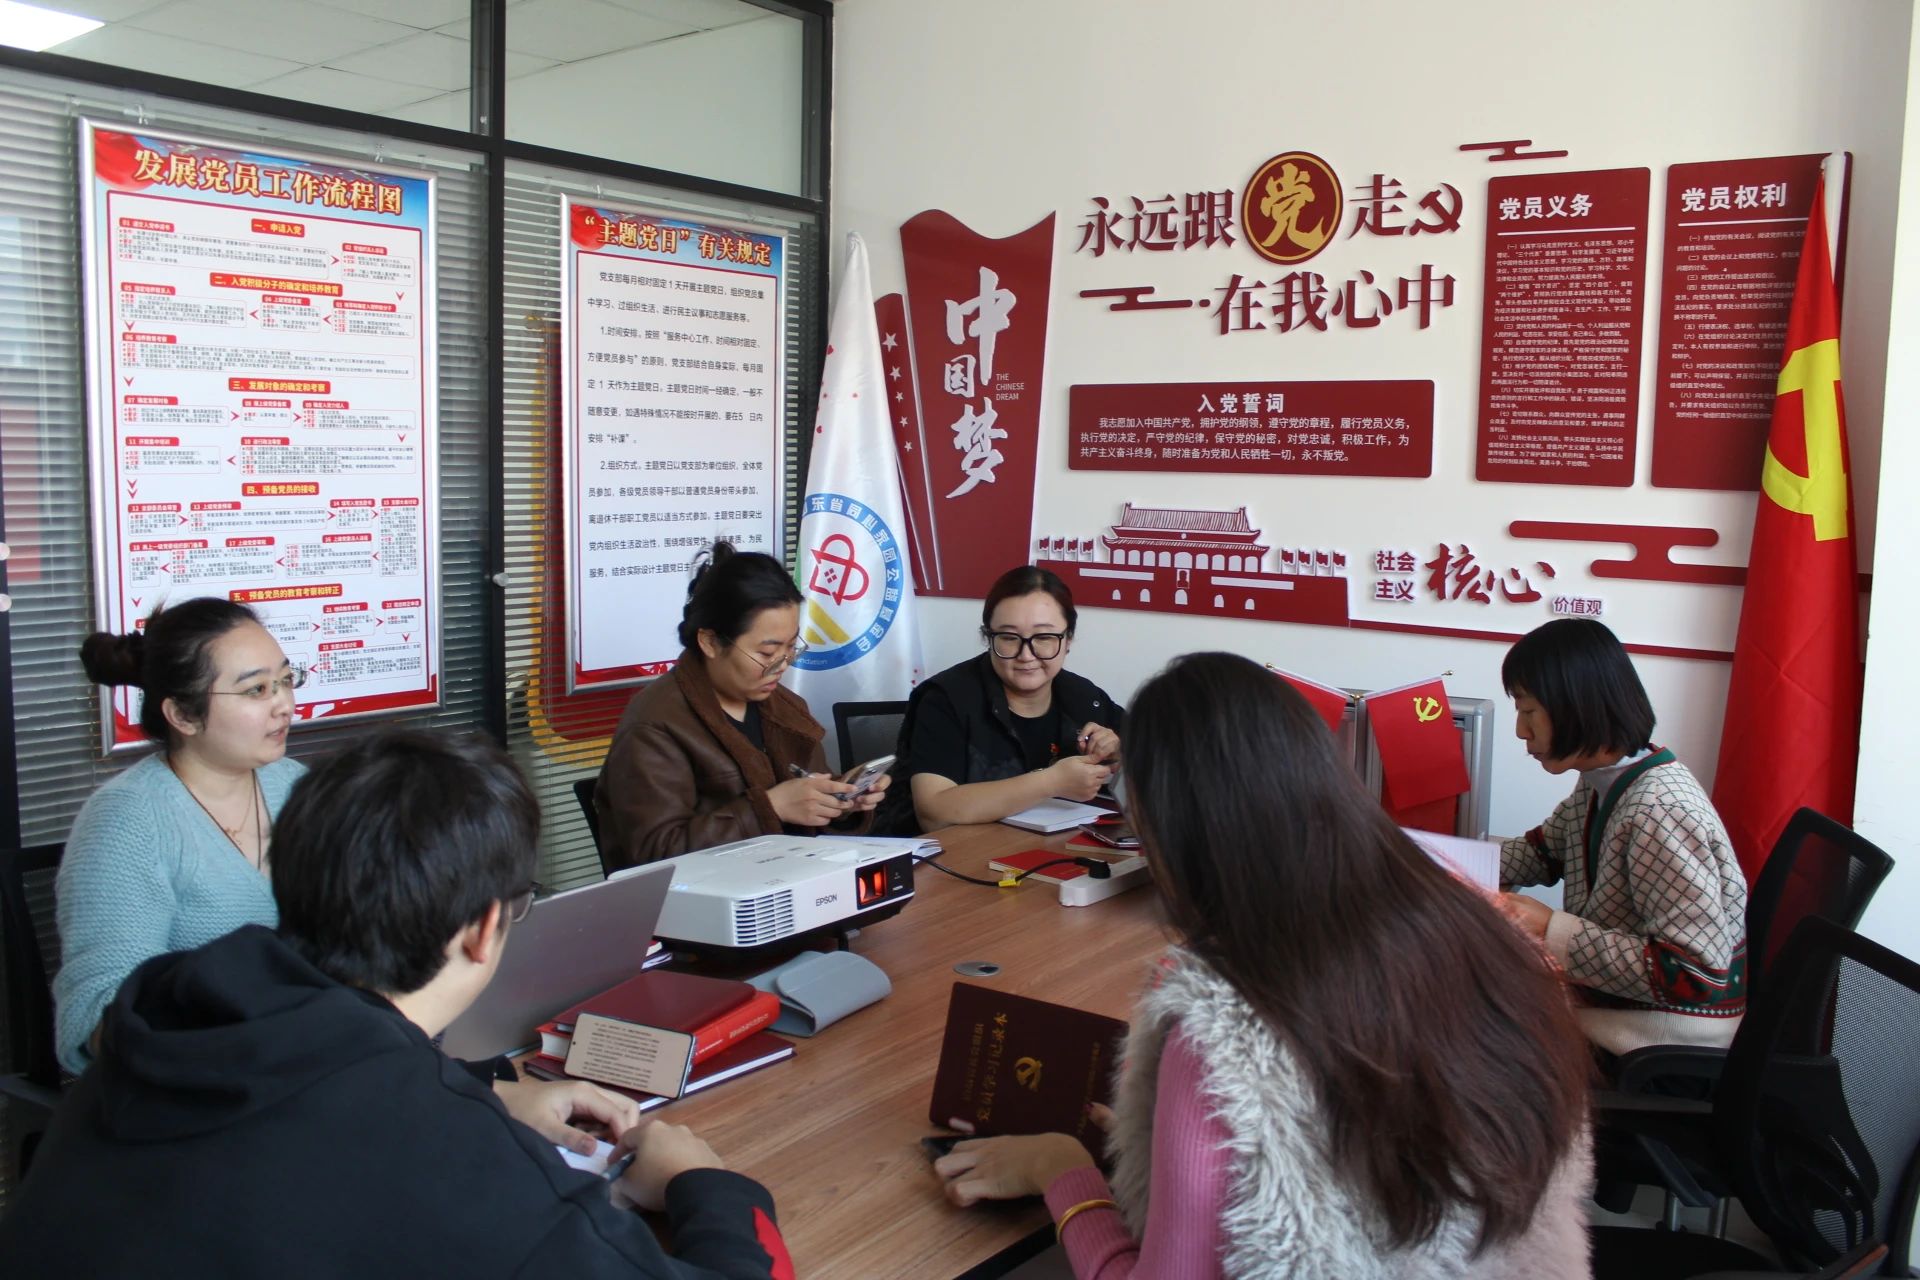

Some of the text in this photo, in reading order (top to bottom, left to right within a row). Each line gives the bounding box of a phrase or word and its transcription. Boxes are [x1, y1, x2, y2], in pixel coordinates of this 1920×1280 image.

[134, 148, 403, 216] 发展党员工作流程图
[1499, 193, 1593, 220] 党员义务
[1681, 183, 1787, 212] 党员权利
[254, 222, 302, 235] 一、申请入党
[585, 216, 772, 266] “主题党日”有关规定
[214, 275, 340, 294] 二、入党积极分子的确定和培养教育
[1212, 264, 1457, 335] 在我心中
[232, 380, 326, 392] 三、发展对象的确定和考察
[945, 266, 1017, 499] 中国梦
[996, 373, 1010, 382] THE
[996, 383, 1025, 391] CHINESE
[996, 393, 1020, 401] DREAM
[1197, 393, 1284, 414] 入党誓词
[1080, 432, 1410, 446] 执行党的决定，严守党的纪律，保守党的秘密，对党忠诚，积极工作，为
[1080, 447, 1349, 462] 共产主义奋斗终身，随时准备为党和人民牺牲一切，永不叛党。
[246, 485, 317, 496] 四、预备党员的接收
[1376, 551, 1415, 572] 社会
[1425, 543, 1556, 604] 核心
[233, 586, 340, 601] 五、预备党员的教育考察和转正
[1376, 579, 1414, 601] 主义
[1553, 597, 1602, 616] 价值观
[815, 893, 838, 907] EPSON
